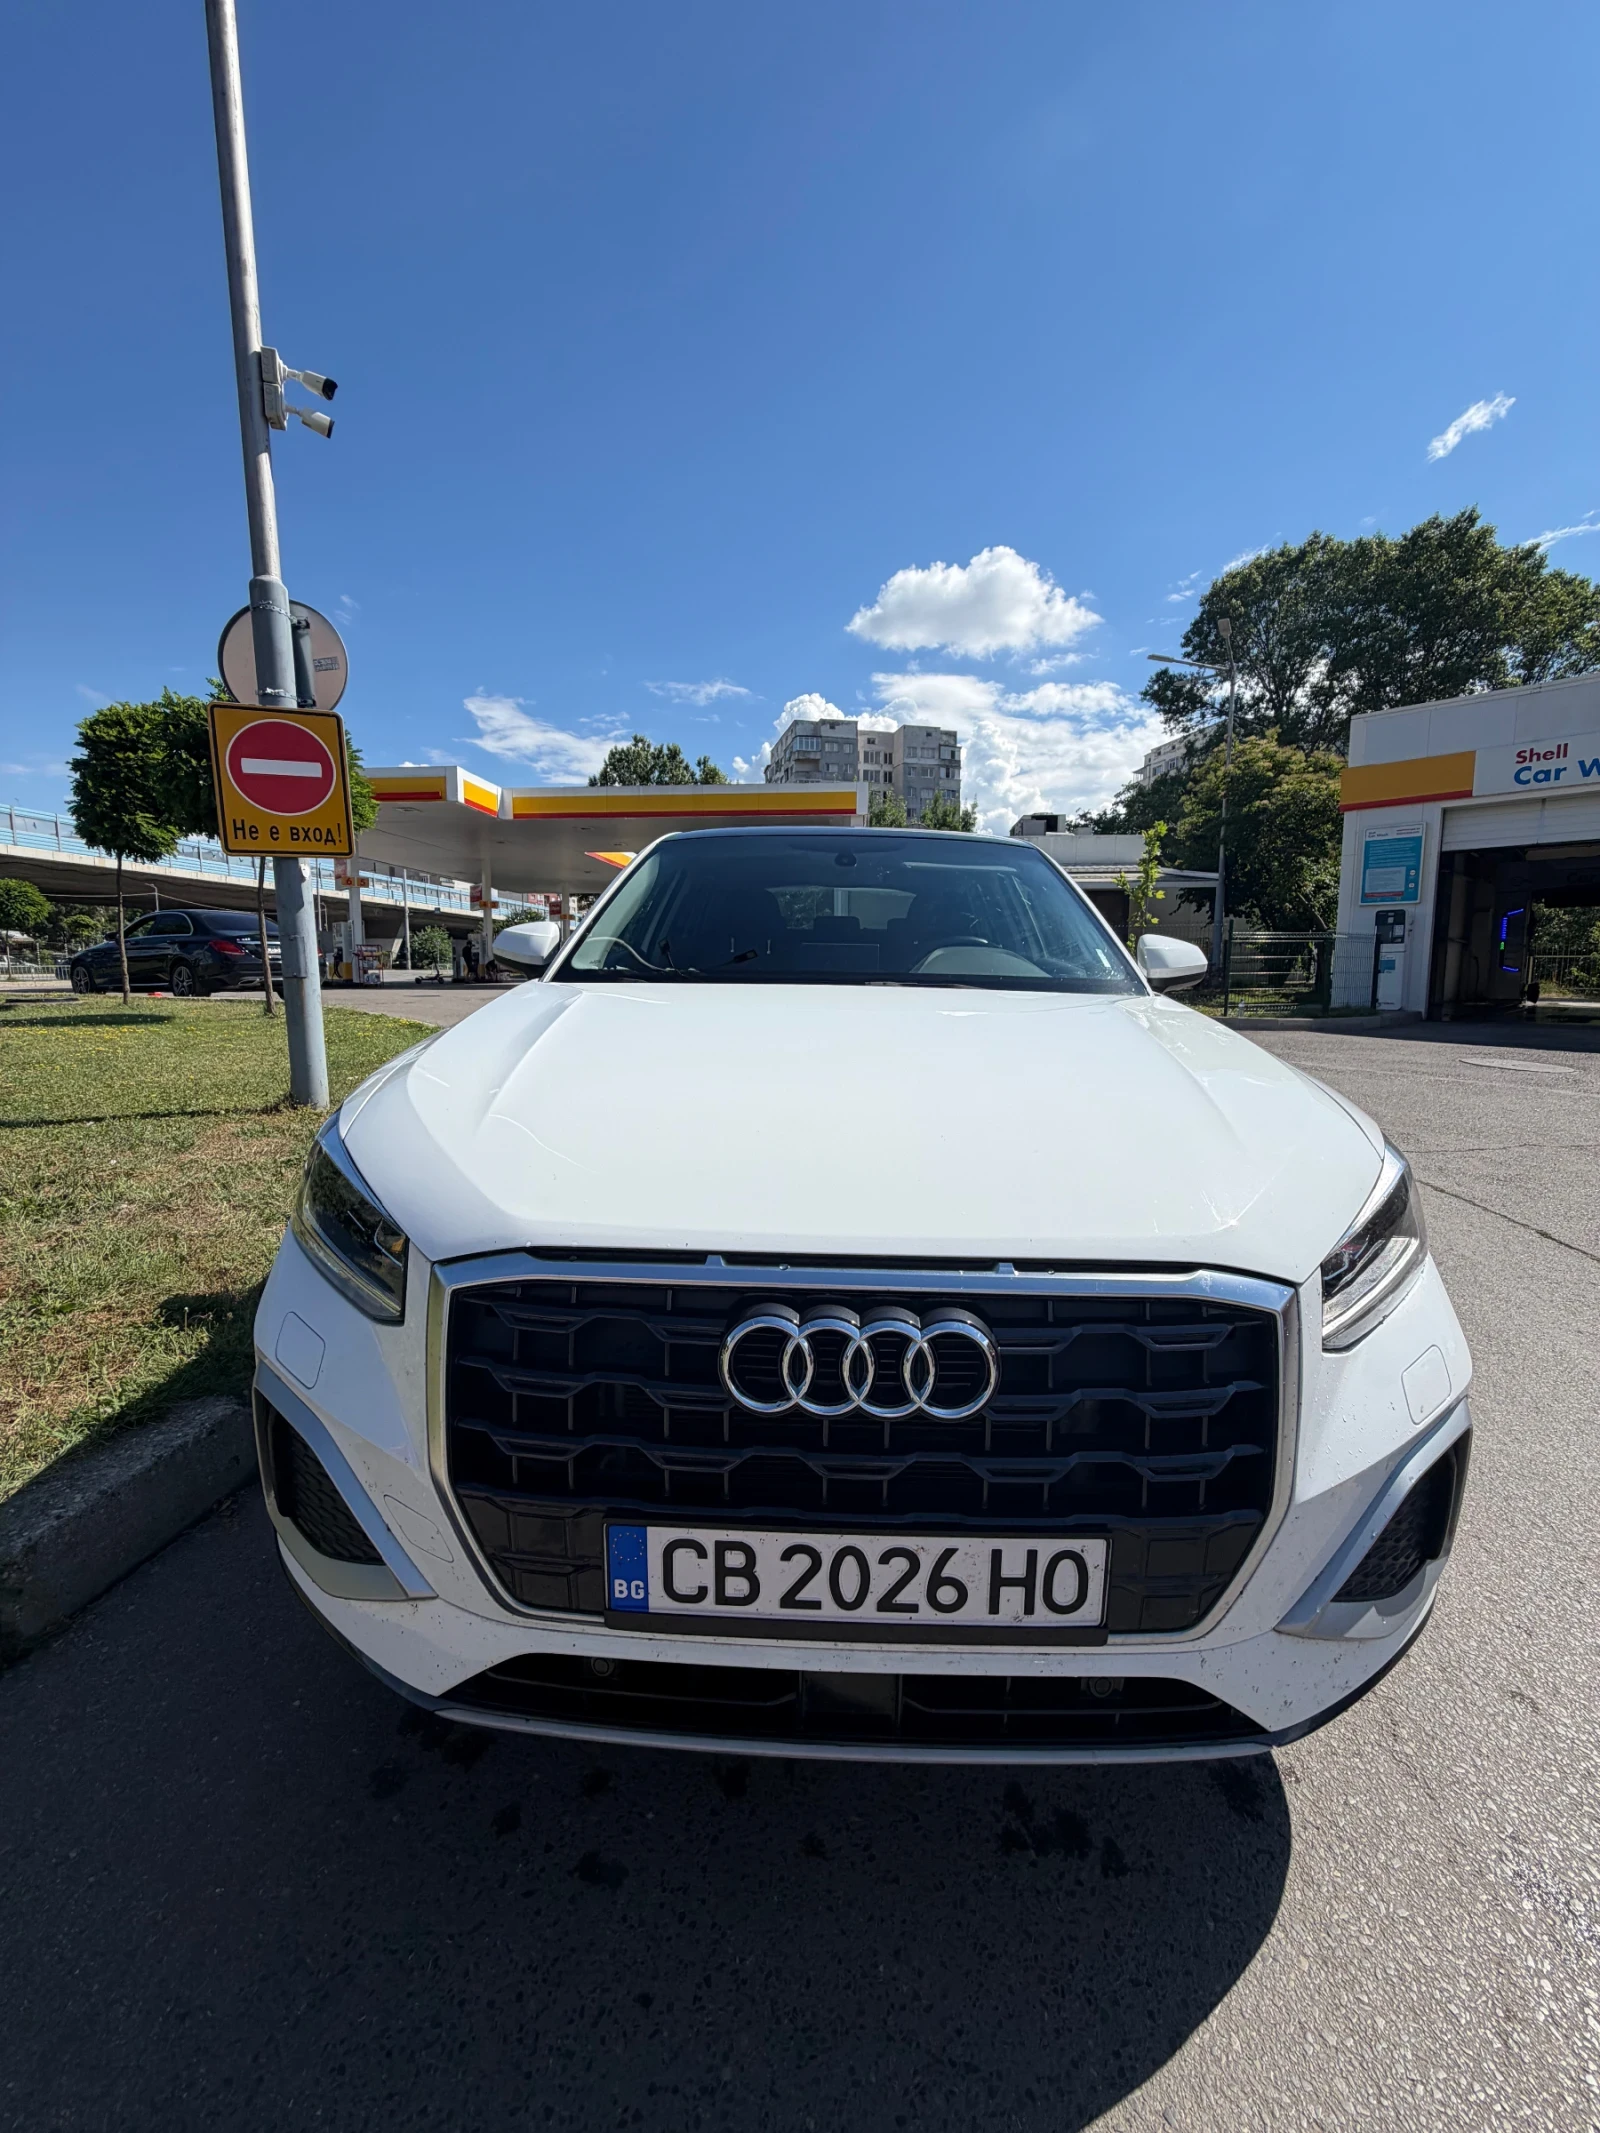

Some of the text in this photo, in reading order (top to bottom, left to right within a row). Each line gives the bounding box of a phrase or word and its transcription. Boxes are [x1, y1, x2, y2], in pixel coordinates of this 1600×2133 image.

[1515, 743, 1569, 764] Shell
[1513, 765, 1567, 785] Car
[232, 819, 342, 845] Не е вход!
[661, 1538, 1089, 1615] CB 2026 HO
[613, 1578, 645, 1600] BG
